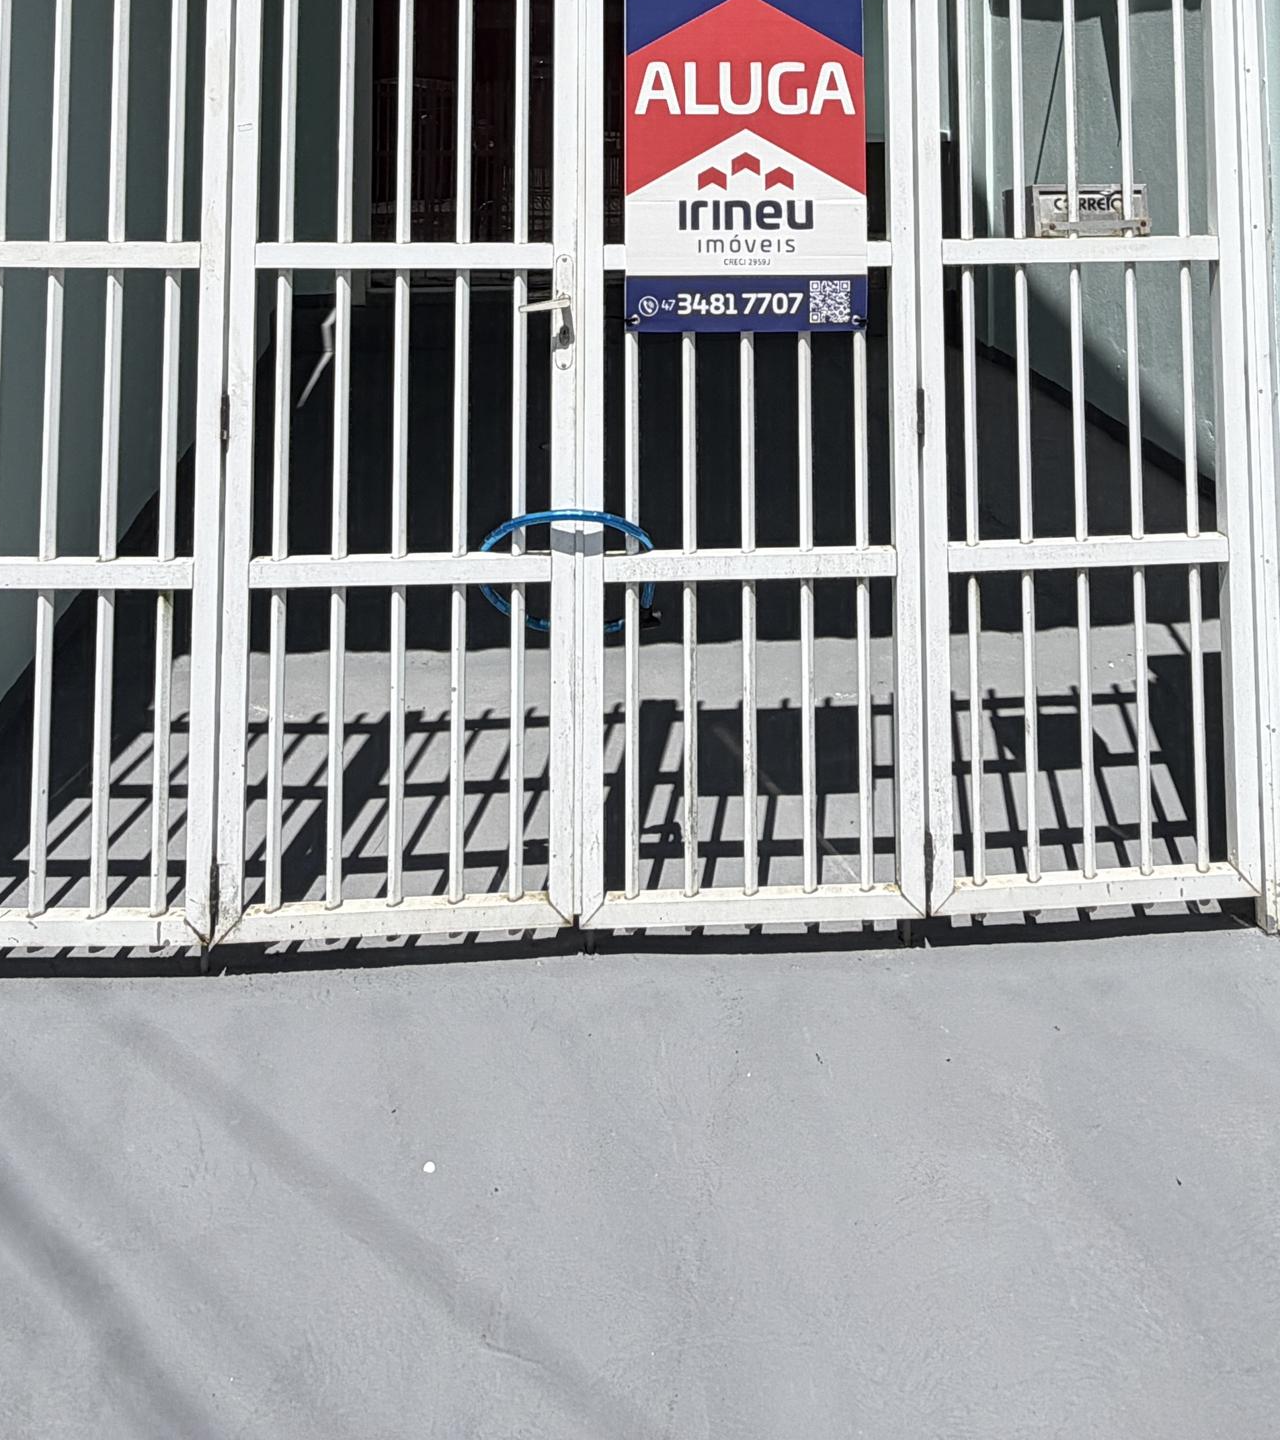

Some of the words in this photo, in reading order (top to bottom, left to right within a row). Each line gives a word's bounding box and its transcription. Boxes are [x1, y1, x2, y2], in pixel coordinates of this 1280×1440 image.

[634, 61, 856, 116] ALUGA
[679, 200, 814, 230] irineu
[698, 234, 796, 253] imóveis
[723, 258, 746, 266] CRECI
[661, 299, 676, 311] 47
[676, 292, 738, 315] 3481
[741, 292, 804, 315] 7707
